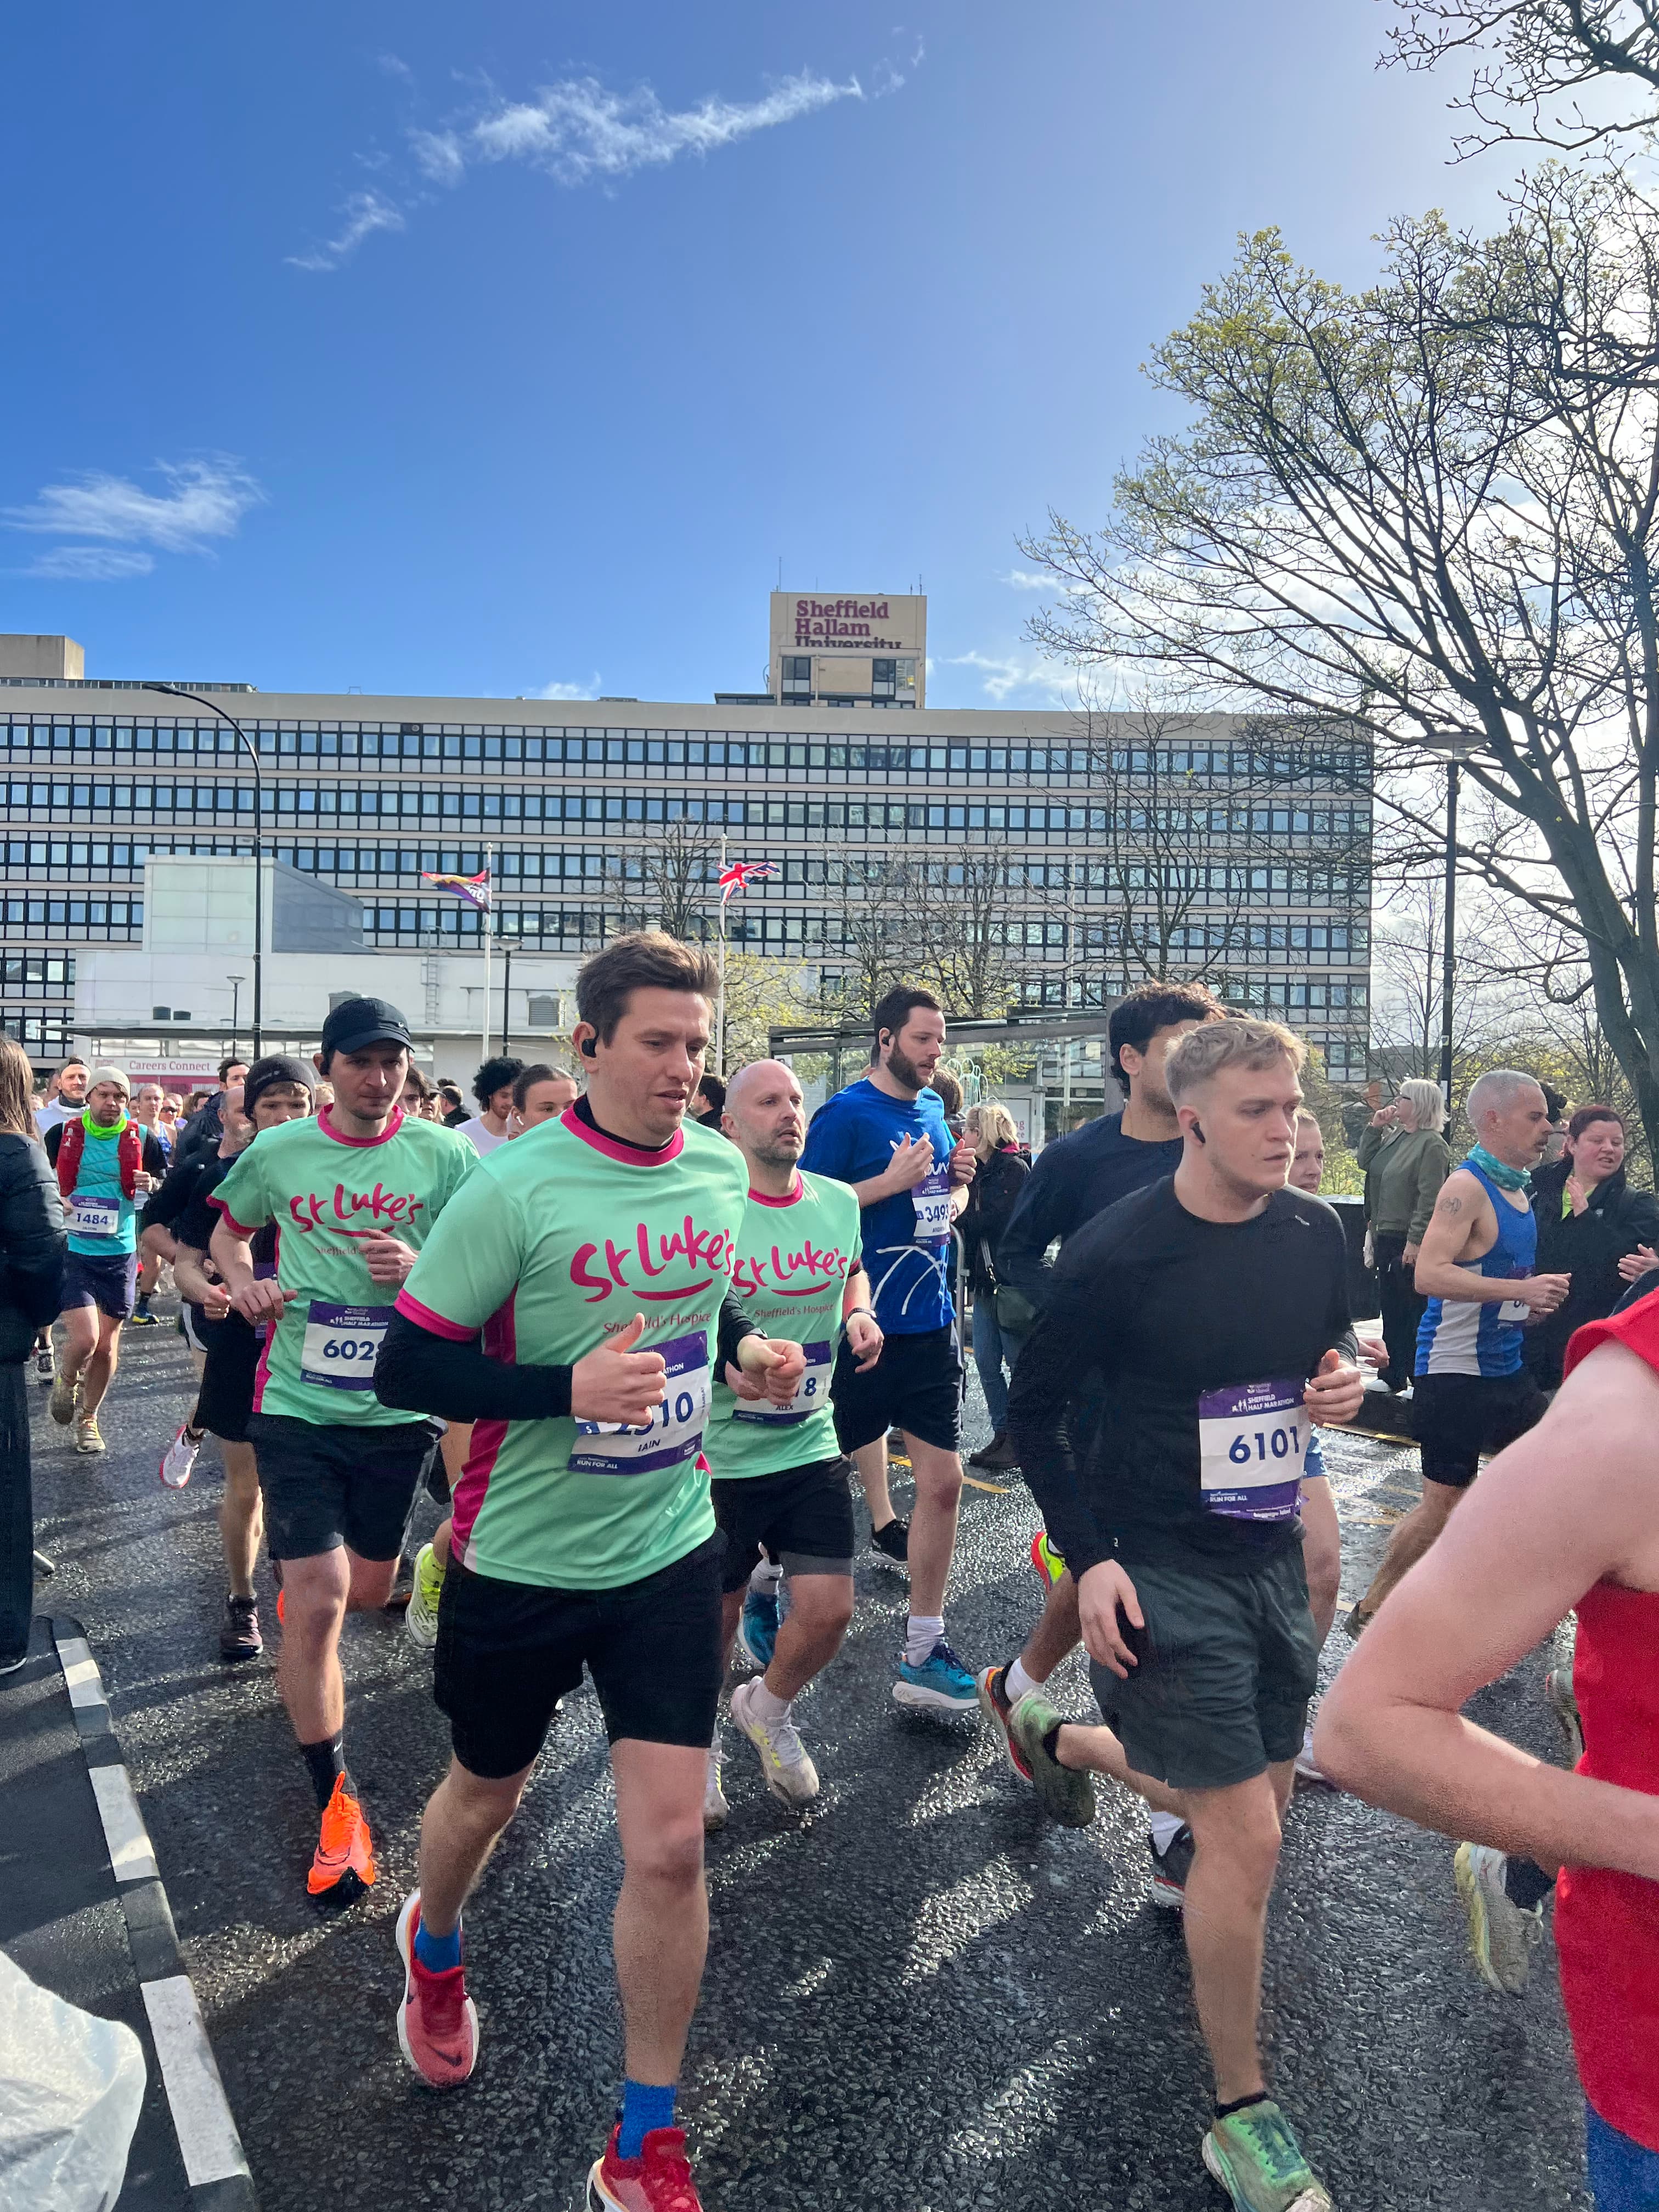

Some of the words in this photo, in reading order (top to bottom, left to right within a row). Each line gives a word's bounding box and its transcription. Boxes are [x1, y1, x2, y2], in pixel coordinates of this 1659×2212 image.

[797, 600, 889, 619] Sheffield
[795, 618, 871, 636] Hallam
[129, 1060, 166, 1070] Careers
[169, 1061, 210, 1071] Connect
[289, 1193, 328, 1233] St
[334, 1182, 424, 1225] Luke's
[77, 1213, 109, 1225] 1484
[569, 1239, 632, 1303] St
[636, 1215, 735, 1277] Luke's
[731, 1256, 769, 1298] St
[771, 1240, 848, 1279] Luke's
[754, 1306, 802, 1318] Sheffield's
[804, 1302, 834, 1315] Hospice
[323, 1339, 379, 1361] 602
[637, 1438, 661, 1453] IAIN
[1229, 1426, 1299, 1464] 6101
